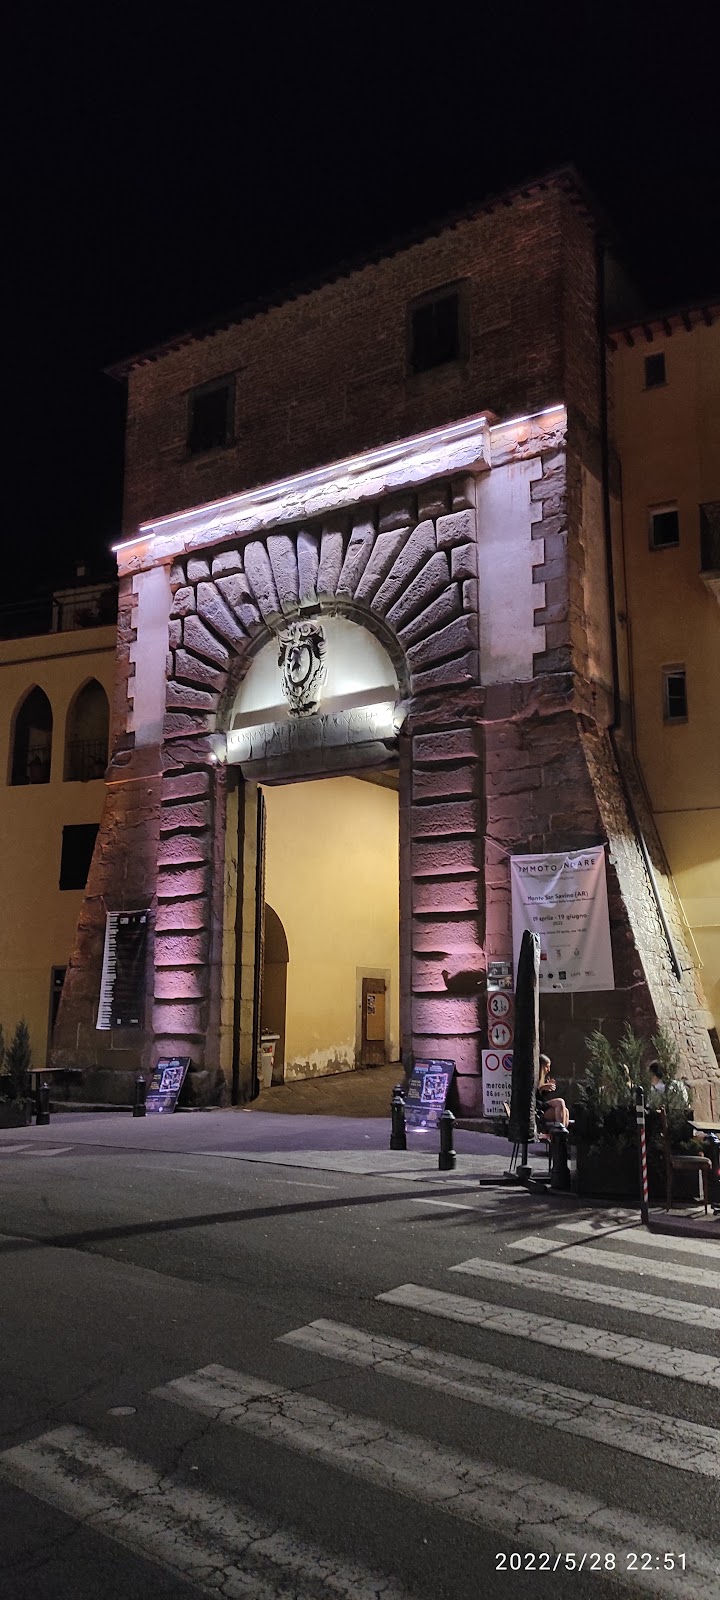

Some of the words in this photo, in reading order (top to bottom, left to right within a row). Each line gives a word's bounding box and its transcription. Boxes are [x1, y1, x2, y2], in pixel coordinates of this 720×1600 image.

[561, 858, 596, 869] NDARE
[574, 890, 589, 898] (AR)
[566, 913, 588, 921] giugno
